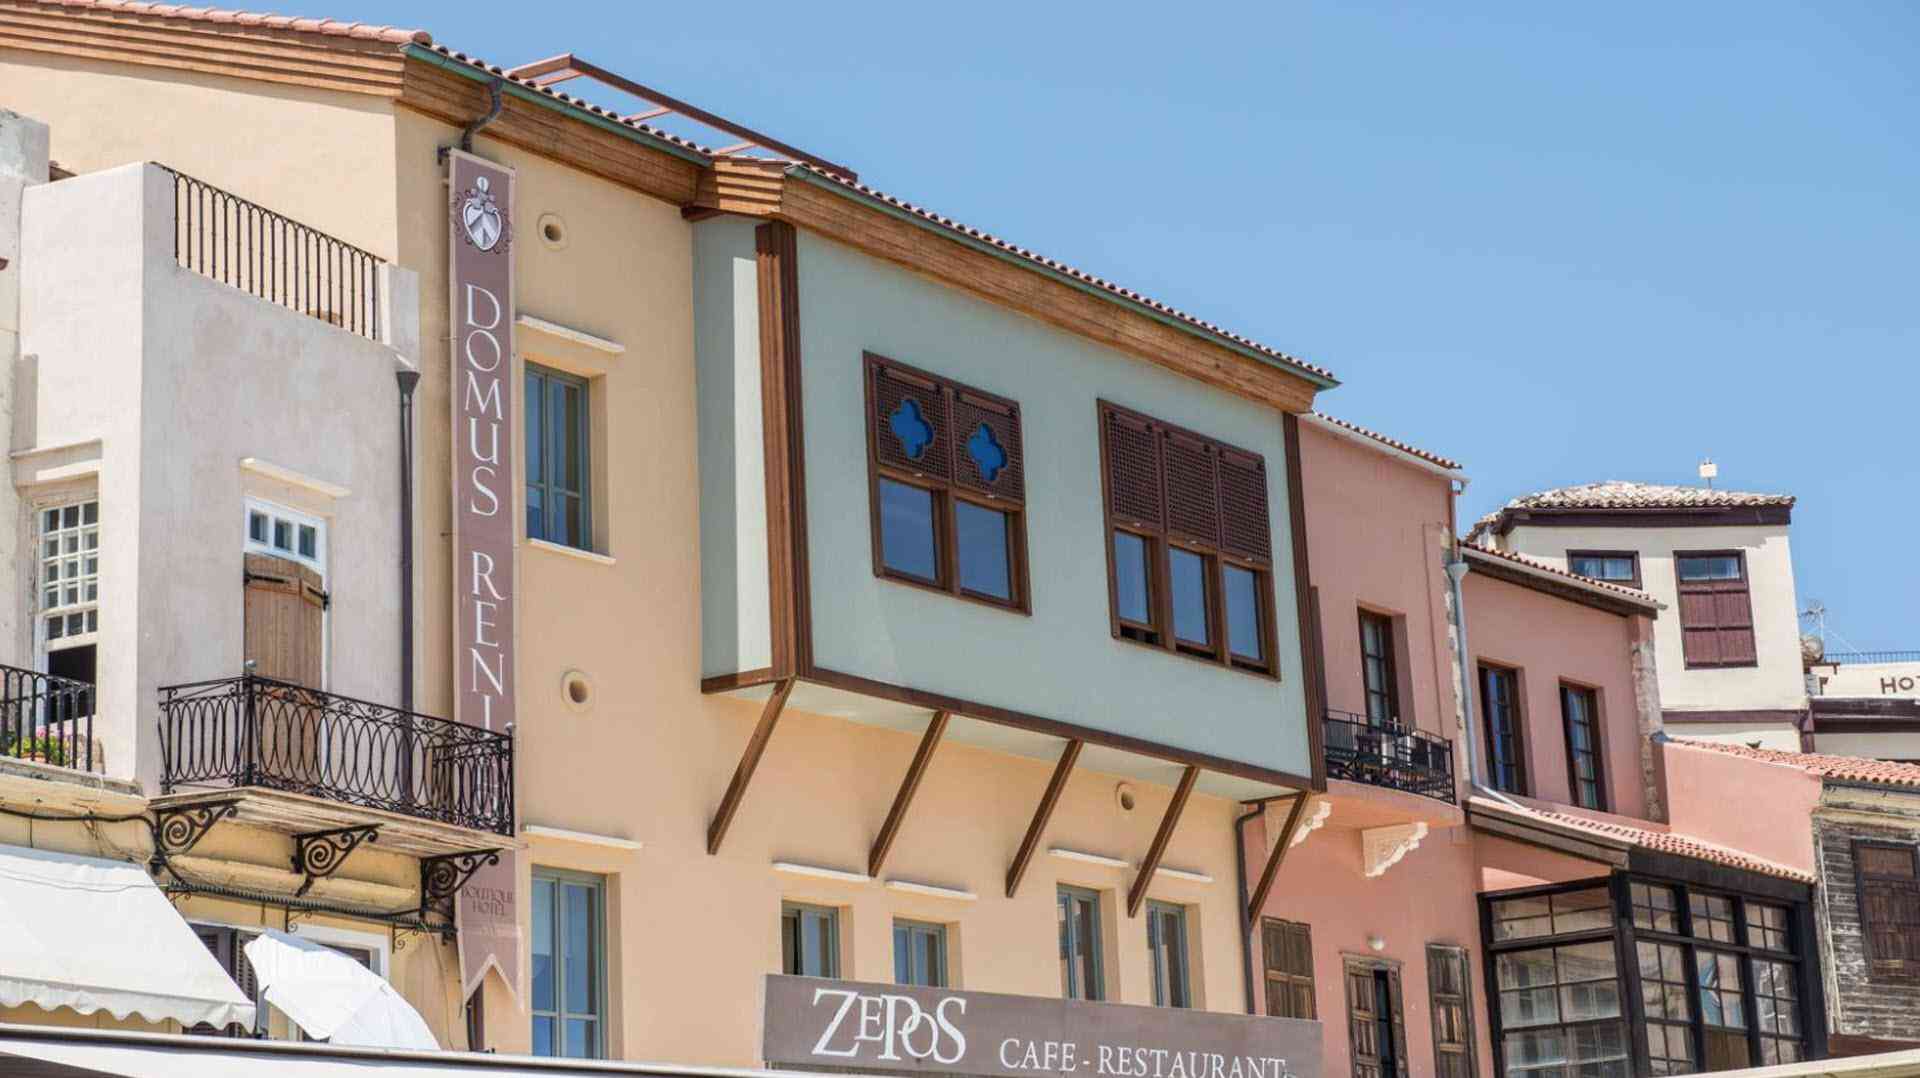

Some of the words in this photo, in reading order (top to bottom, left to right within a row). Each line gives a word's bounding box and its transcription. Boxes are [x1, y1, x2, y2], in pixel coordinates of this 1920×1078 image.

[464, 283, 503, 518] DOMUS
[469, 550, 506, 832] RENI
[1879, 675, 1920, 694] HO
[810, 987, 967, 1064] ZEPOS
[999, 1038, 1077, 1072] CAFE
[1097, 1044, 1286, 1078] RESTAURANT
